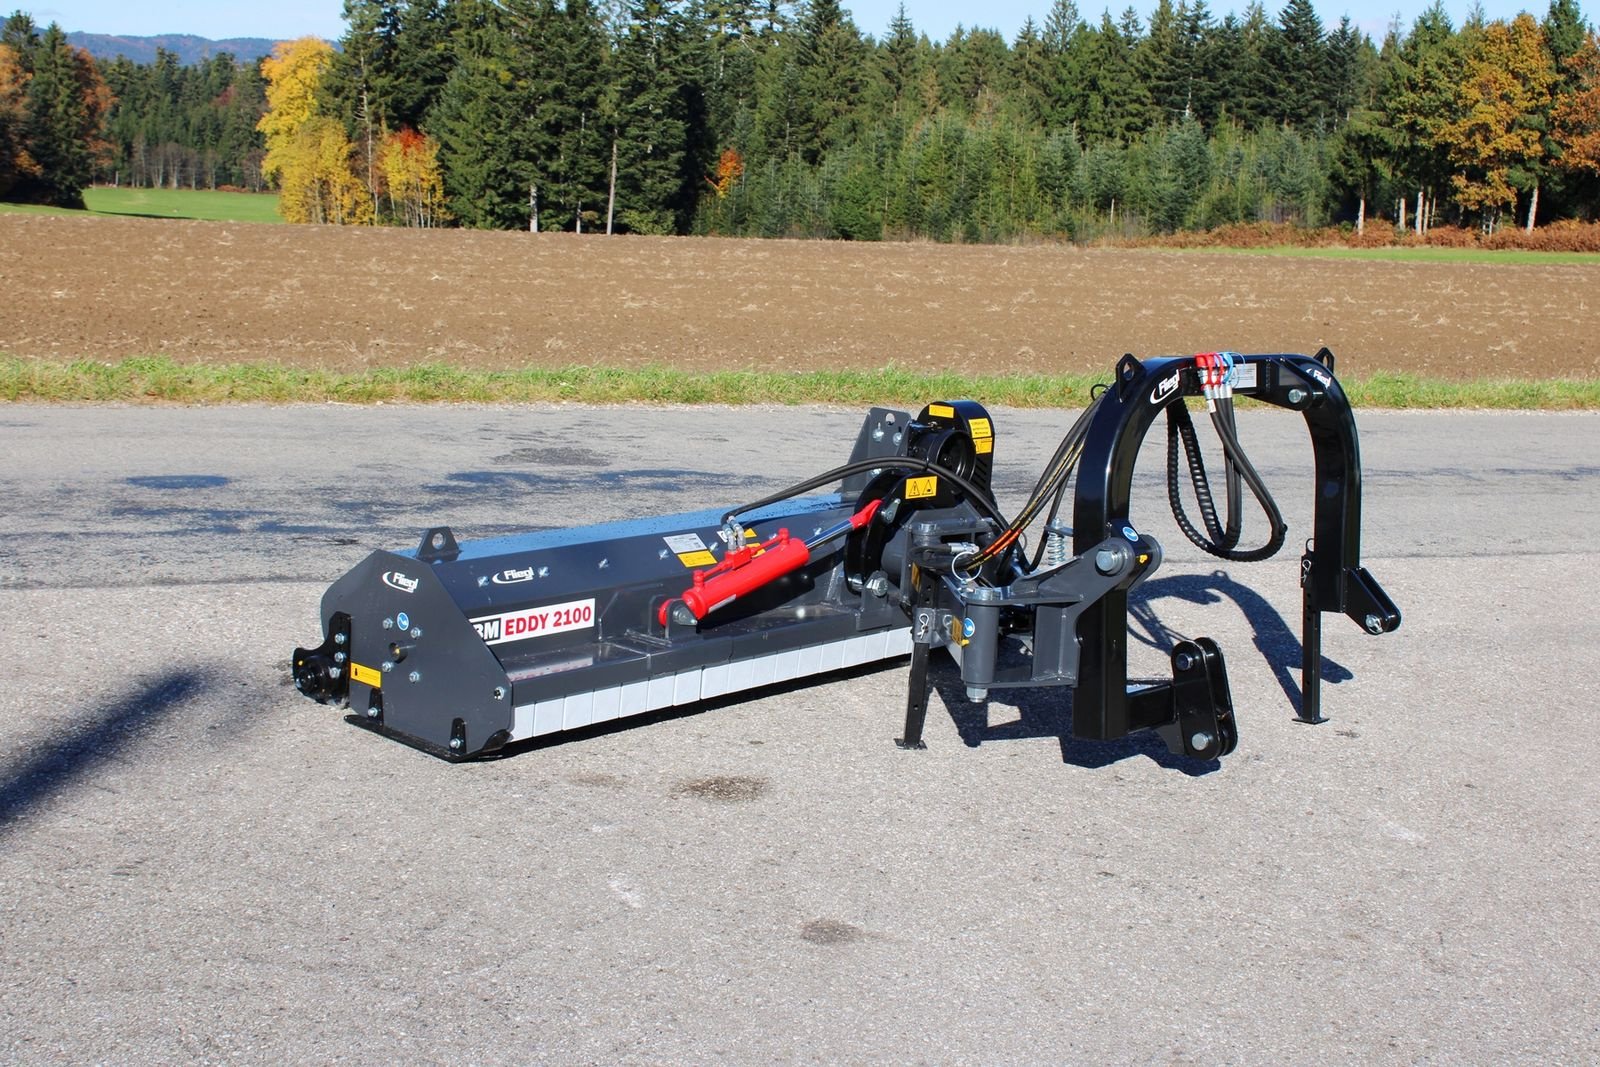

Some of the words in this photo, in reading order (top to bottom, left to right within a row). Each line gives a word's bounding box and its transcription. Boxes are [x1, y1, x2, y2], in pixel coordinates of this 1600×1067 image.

[392, 572, 419, 592] Fliegl
[503, 566, 535, 581] Fliegl
[505, 613, 549, 636] EDDY
[553, 606, 591, 628] 2100
